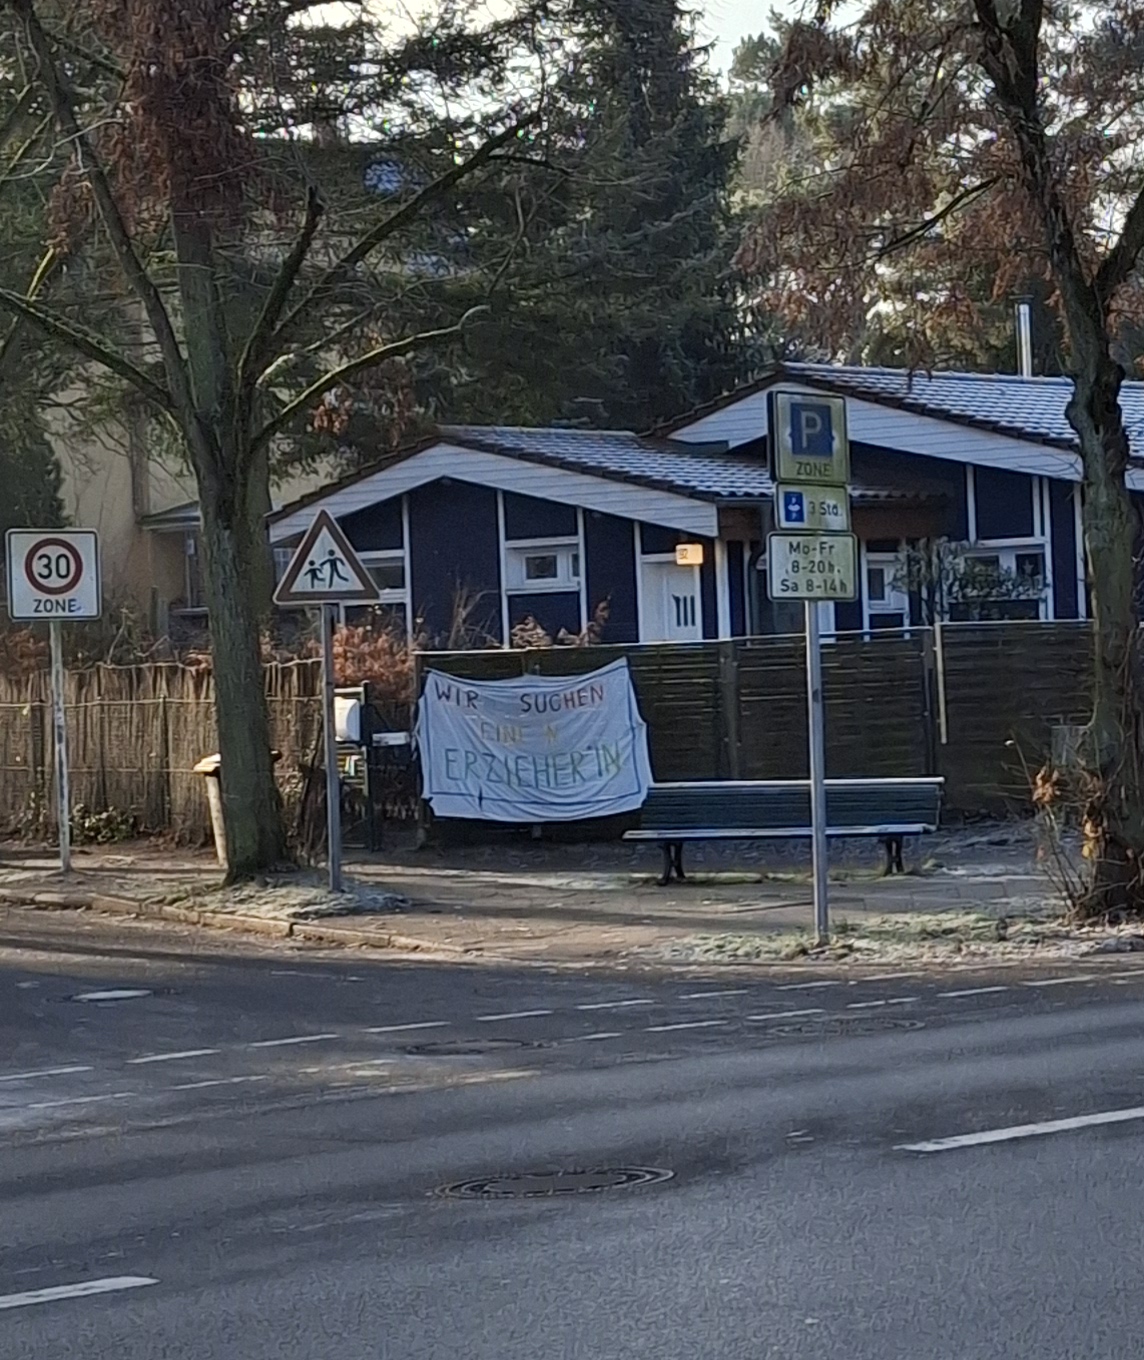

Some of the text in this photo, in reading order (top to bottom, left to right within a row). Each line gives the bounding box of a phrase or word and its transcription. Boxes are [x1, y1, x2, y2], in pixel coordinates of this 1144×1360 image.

[800, 410, 822, 449] P
[796, 461, 831, 478] ZONE
[808, 501, 815, 515] 3
[789, 541, 835, 555] Mo-Fr
[37, 553, 71, 579] 30
[780, 579, 799, 592] Sa
[33, 598, 77, 613] ZONE
[435, 681, 604, 714] WIR SUCHEN
